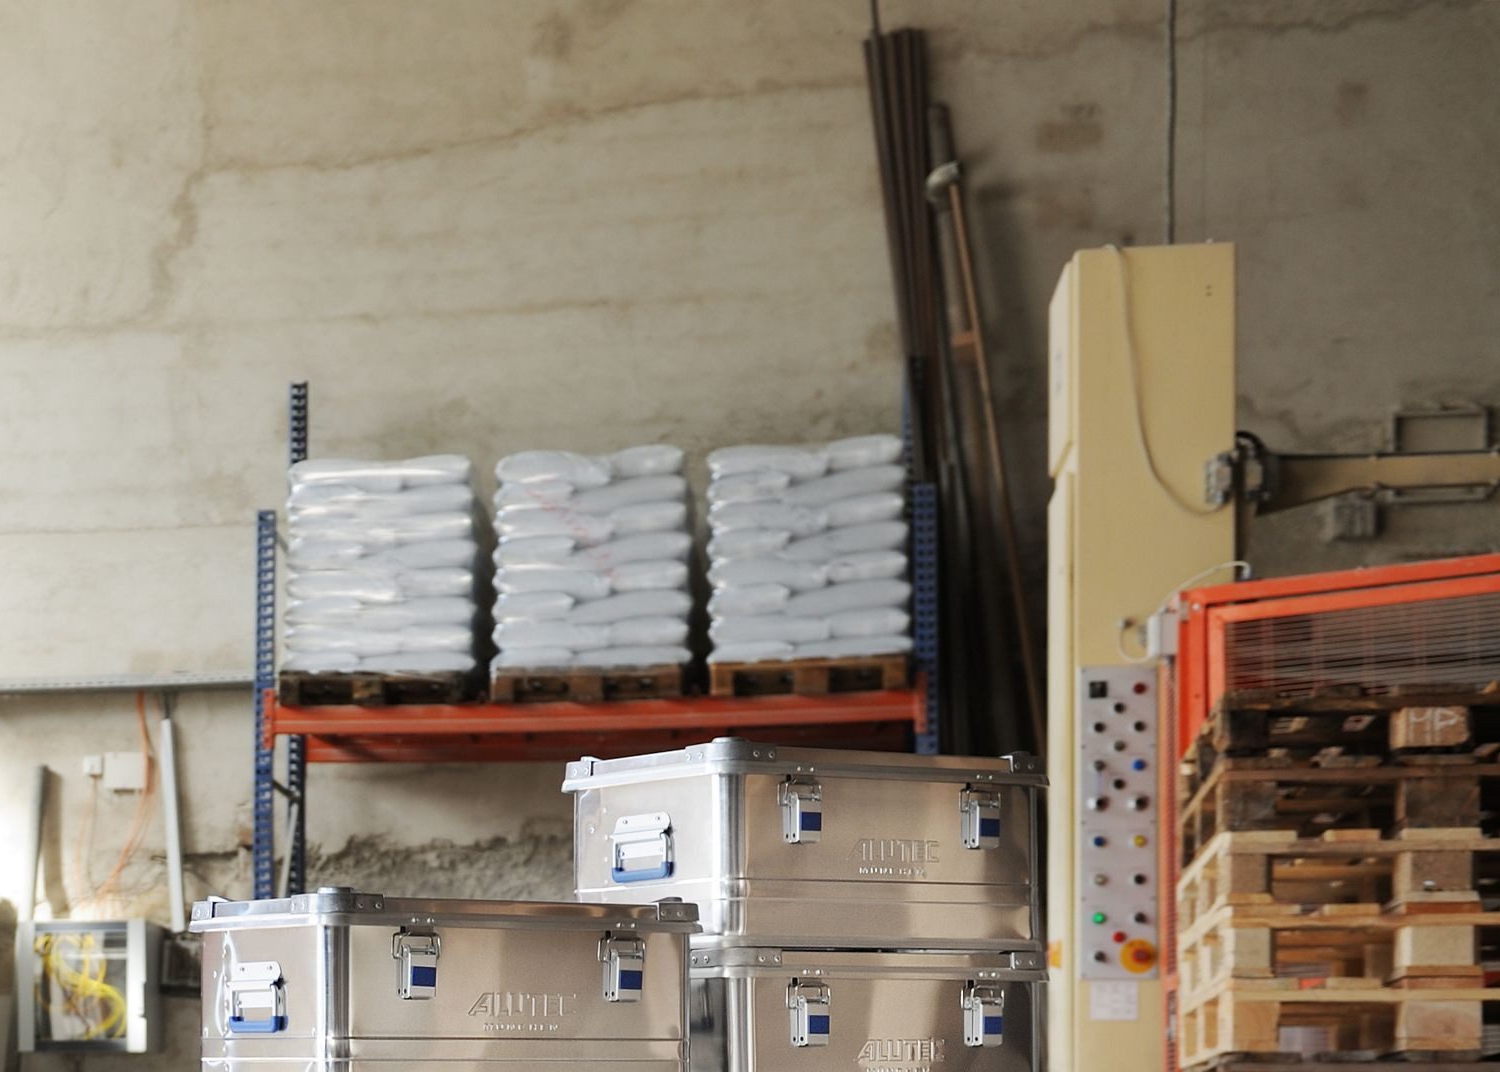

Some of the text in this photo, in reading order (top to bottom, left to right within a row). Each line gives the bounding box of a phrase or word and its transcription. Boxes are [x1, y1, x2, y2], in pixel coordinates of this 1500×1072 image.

[846, 837, 940, 863] ALUTEC
[468, 991, 577, 1017] ALUTEC
[854, 1038, 945, 1062] ALUTEC
